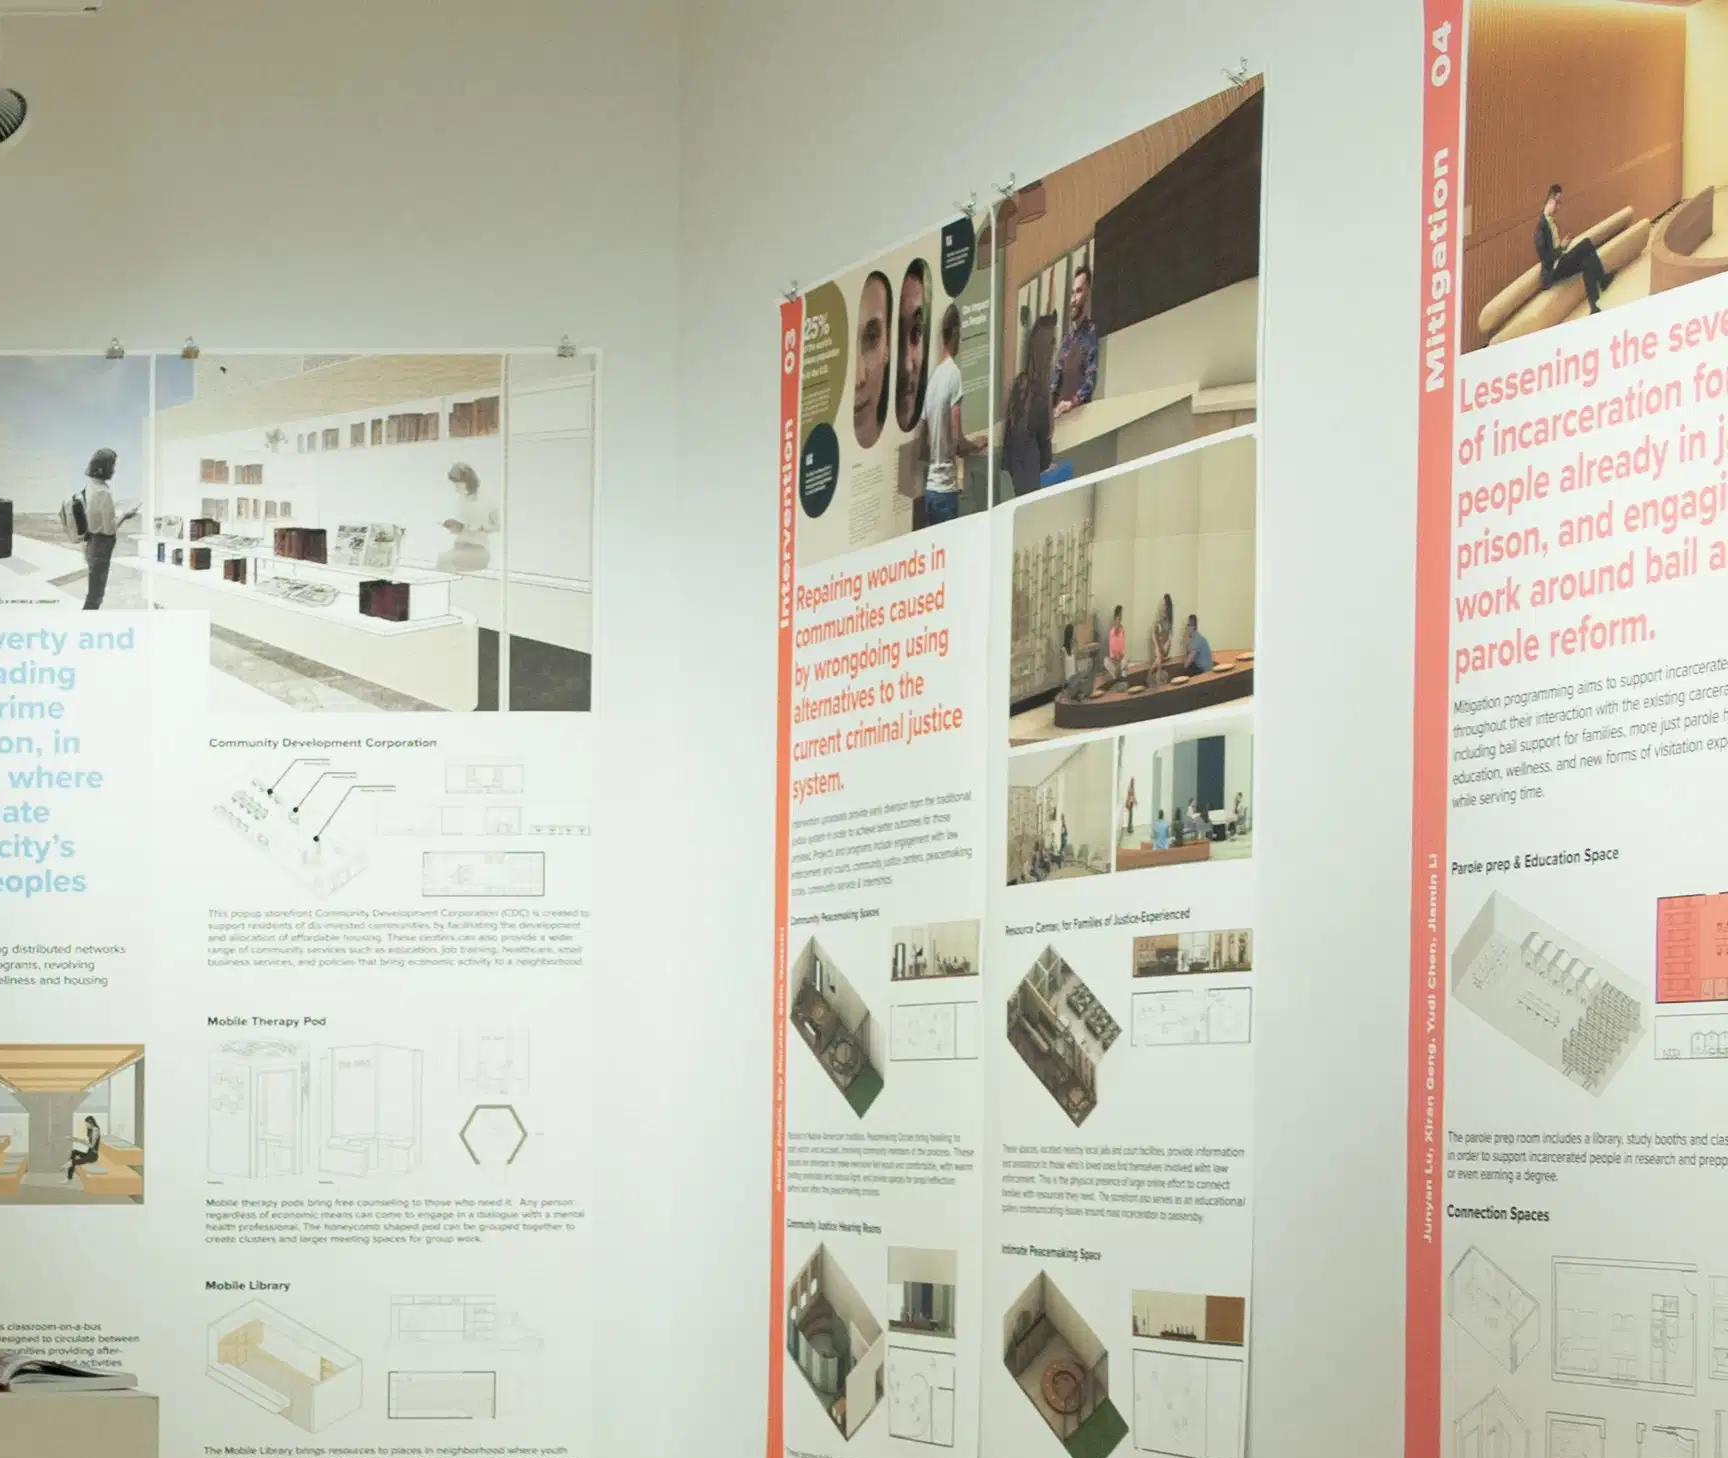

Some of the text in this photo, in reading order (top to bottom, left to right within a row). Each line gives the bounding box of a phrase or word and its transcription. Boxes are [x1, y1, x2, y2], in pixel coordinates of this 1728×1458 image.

[1431, 20, 1451, 88] 04
[1424, 147, 1449, 394] Mitigation
[784, 327, 795, 374] 03
[1460, 329, 1659, 414] Lessening the
[1458, 380, 1682, 466] of incarceration
[1458, 424, 1707, 529] people already in
[779, 419, 793, 628] Intervention
[1457, 500, 1614, 580] prison, and
[797, 544, 946, 613] Repairing wounds in
[1456, 536, 1698, 624] work around bail
[79, 628, 135, 650] and
[796, 582, 946, 649] communities caused
[795, 626, 950, 692] by wrongdoing using
[1455, 614, 1657, 685] parole reform.
[794, 672, 925, 724] alternatives to the
[55, 729, 81, 754] in
[208, 737, 437, 751] Community Development Corporation
[793, 705, 964, 762] current criminal justice
[9, 766, 104, 789] where
[793, 772, 845, 805] system.
[1451, 847, 1620, 877] Parole prep & Education Space
[207, 1016, 327, 1029] Mobile Therapy Pod
[1446, 1203, 1550, 1224] Connection Spaces
[205, 1280, 291, 1294] Mobile Library
